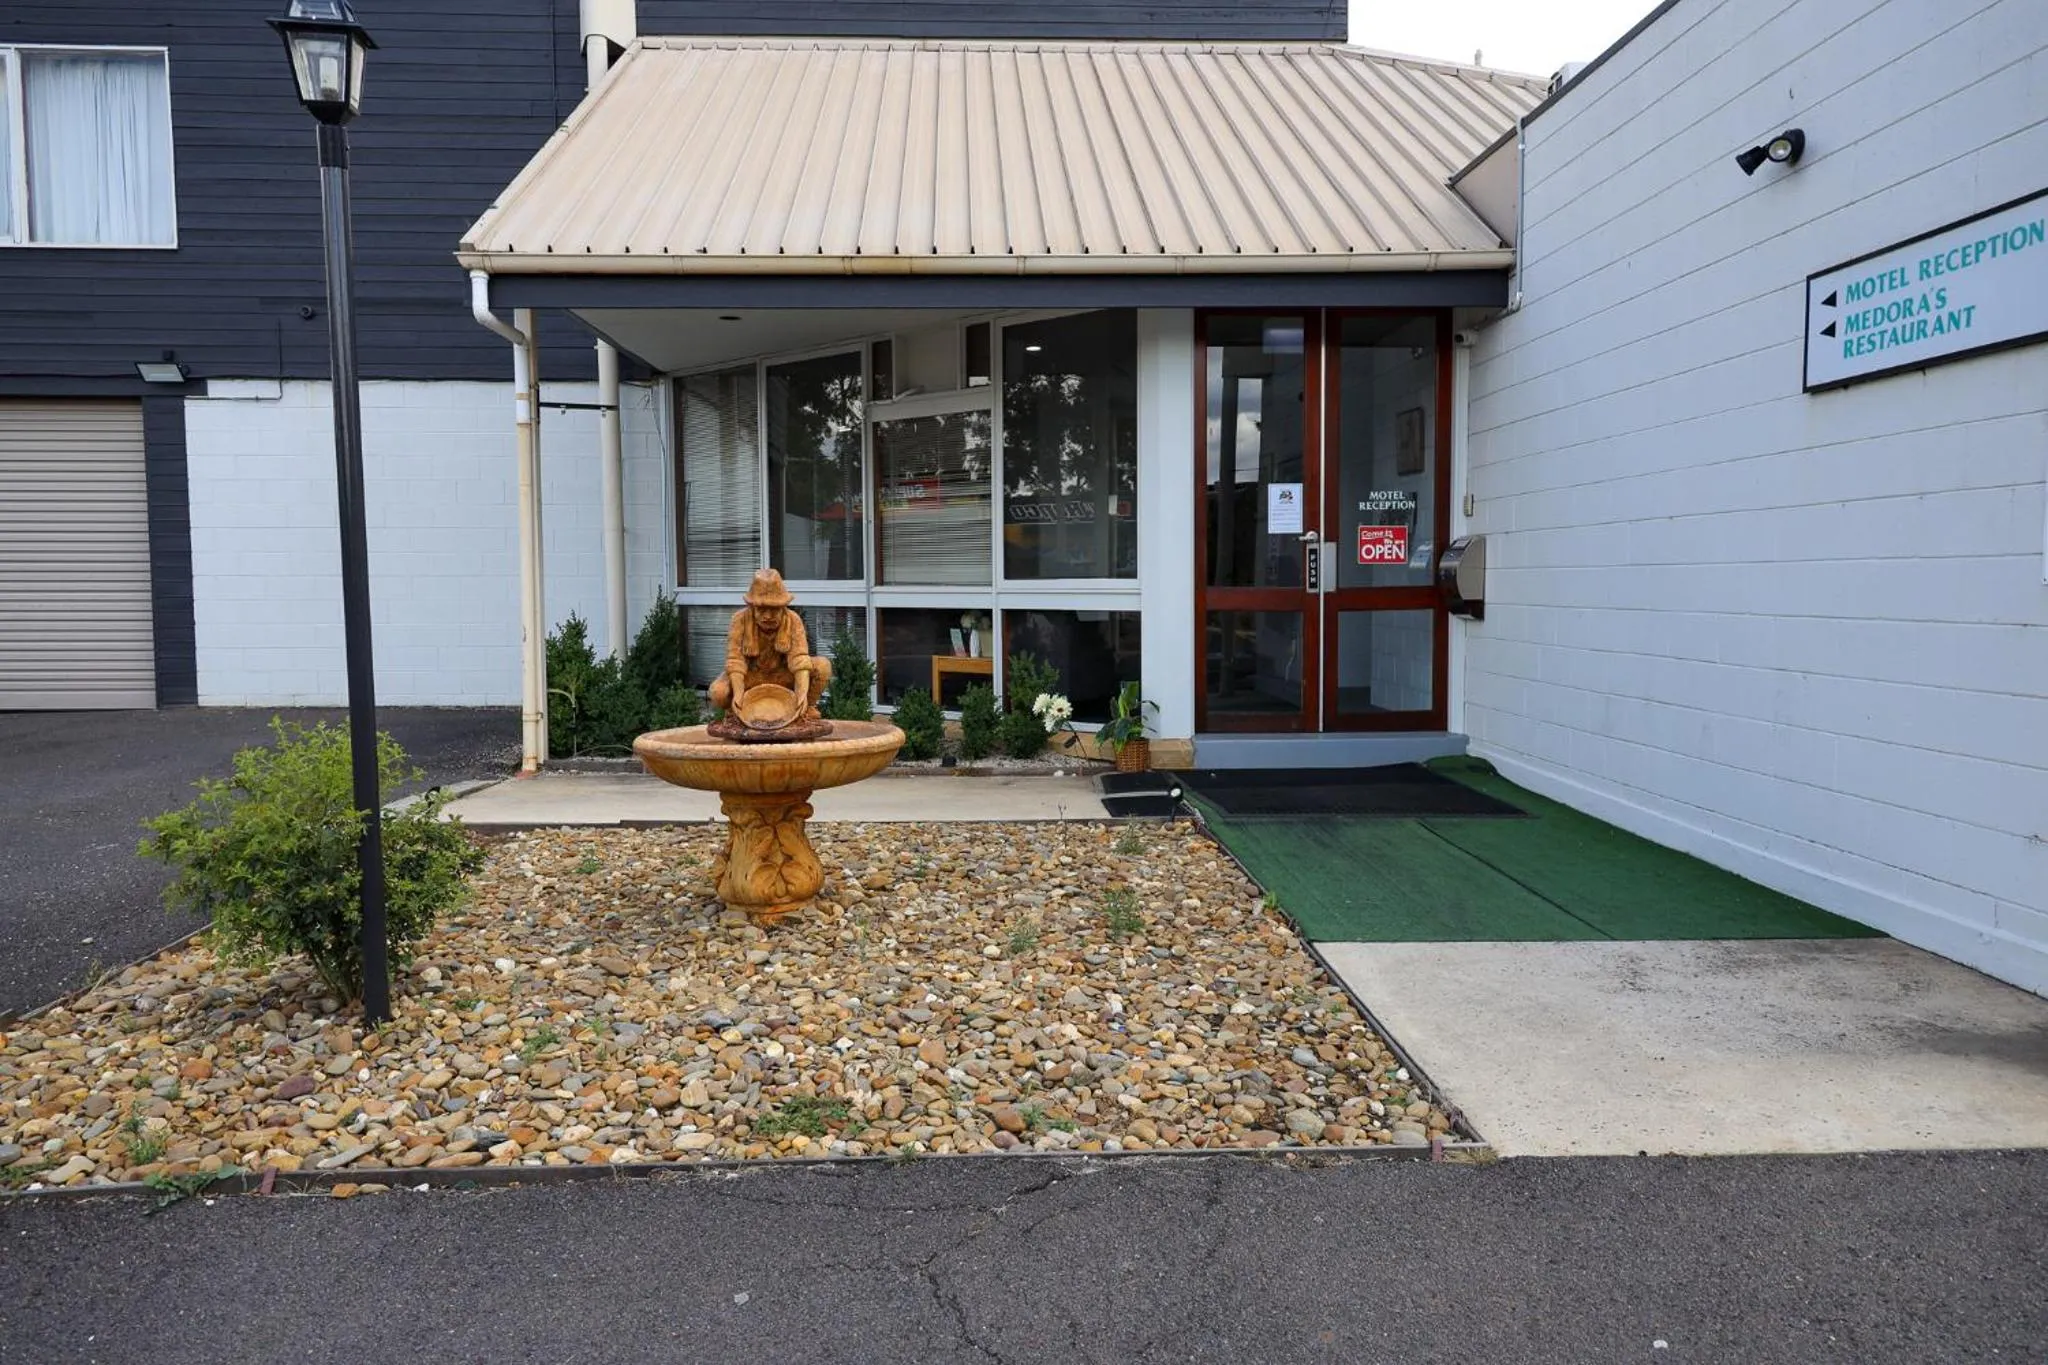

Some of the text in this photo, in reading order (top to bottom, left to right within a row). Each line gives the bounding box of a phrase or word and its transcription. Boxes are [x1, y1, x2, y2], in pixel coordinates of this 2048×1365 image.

[1845, 219, 2045, 305] MOTEL RECEPTION
[1844, 286, 1947, 336] MEDORA'S
[1843, 305, 1976, 359] RESTAURANT
[1359, 500, 1416, 510] RECEPTION
[1369, 490, 1406, 500] MOTEL
[1361, 544, 1405, 560] OPEN
